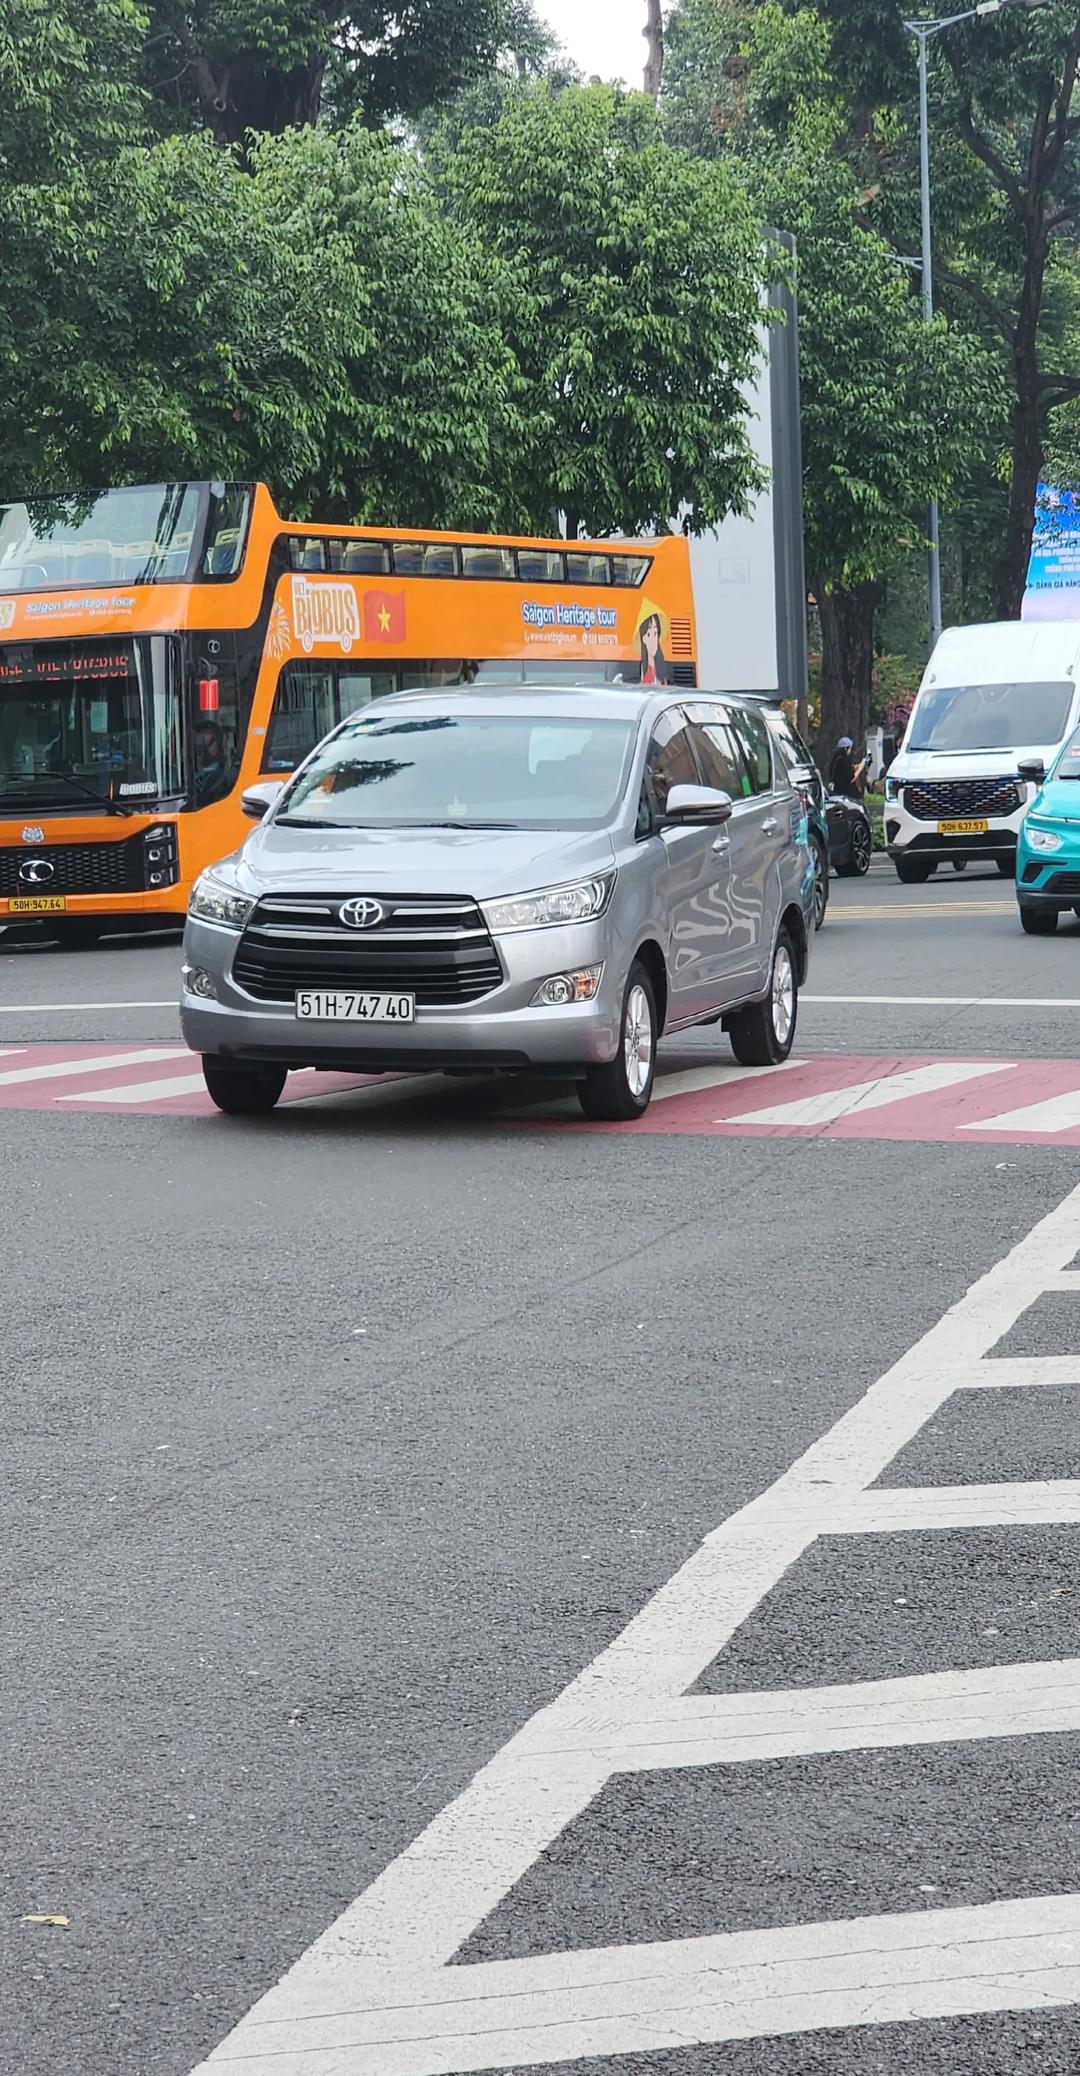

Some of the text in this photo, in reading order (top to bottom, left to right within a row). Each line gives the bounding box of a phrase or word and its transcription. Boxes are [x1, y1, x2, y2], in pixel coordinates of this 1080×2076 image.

[522, 602, 617, 629] Saigon Heritage tour
[13, 899, 61, 910] 50H-947.64
[301, 994, 410, 1018] 51H-747.40
